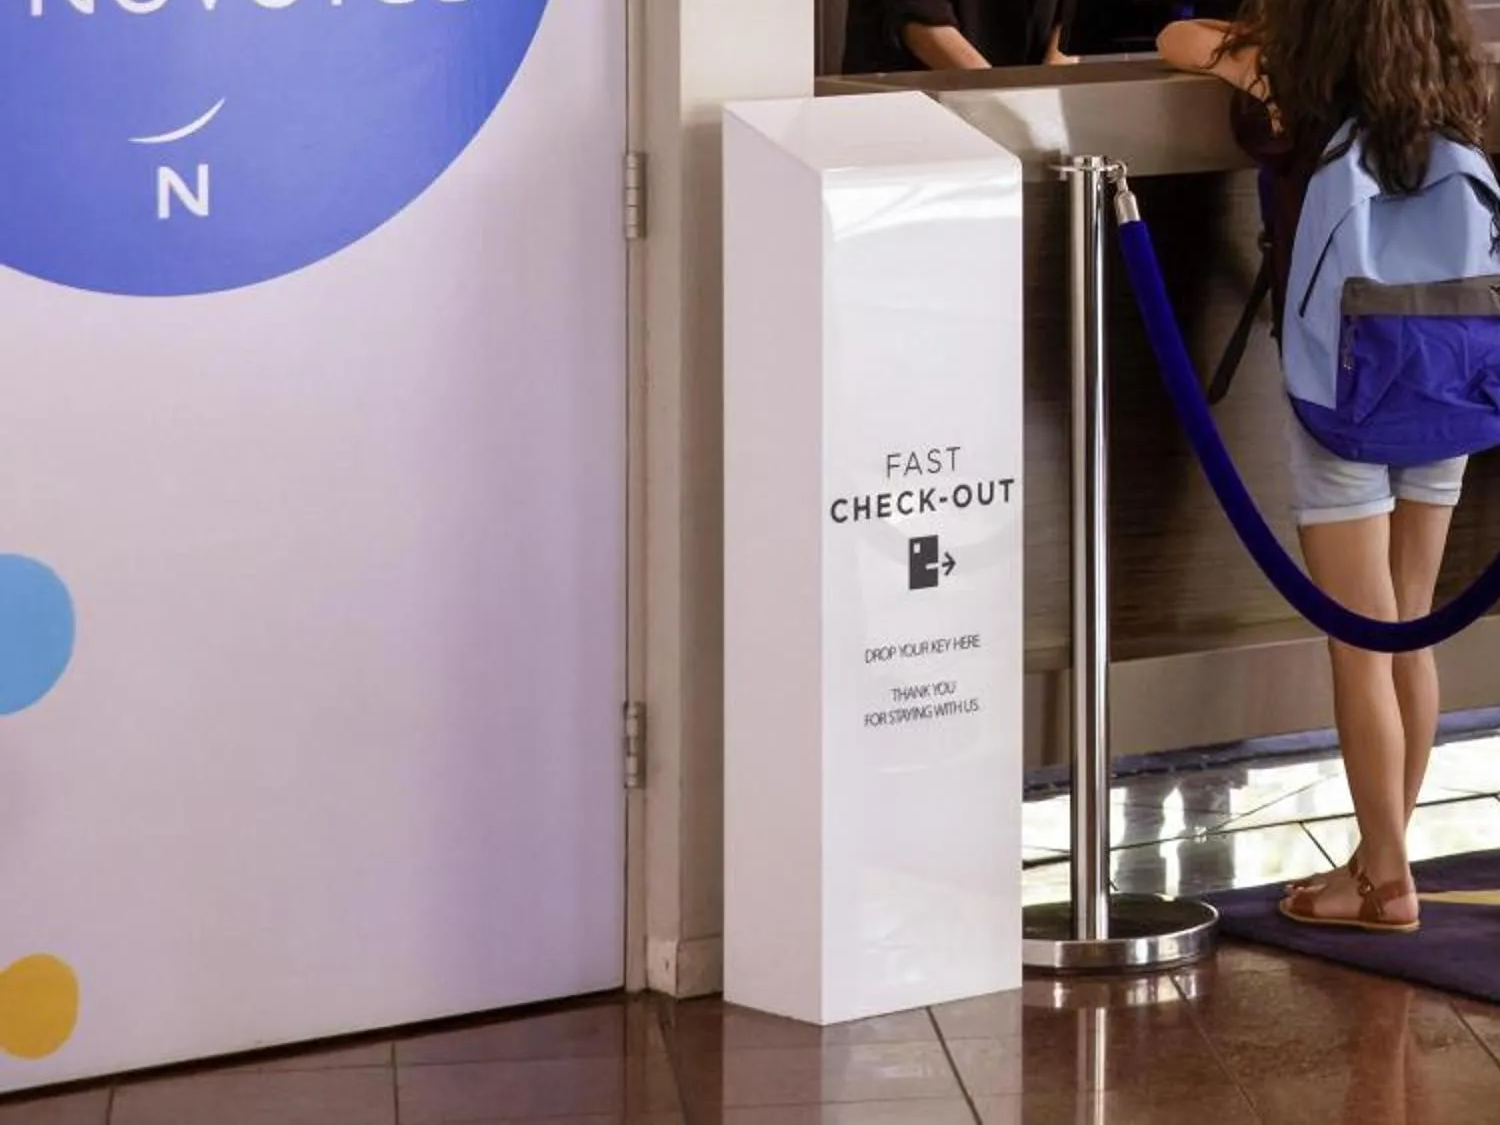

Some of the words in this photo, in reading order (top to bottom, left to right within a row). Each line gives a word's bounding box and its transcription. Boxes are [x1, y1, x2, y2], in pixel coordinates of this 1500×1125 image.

[157, 163, 209, 219] N
[886, 446, 961, 478] FAST
[830, 478, 1015, 523] CHECK-OUT
[865, 645, 896, 663] DROP
[898, 640, 928, 658] YOUR
[931, 638, 951, 654] KEY
[953, 634, 980, 650] HERE
[891, 685, 930, 702] THANK
[932, 680, 957, 696] YOU
[864, 711, 887, 727] FOR
[889, 704, 932, 724] STAYING
[934, 700, 962, 717] WITH
[964, 698, 979, 714] US
